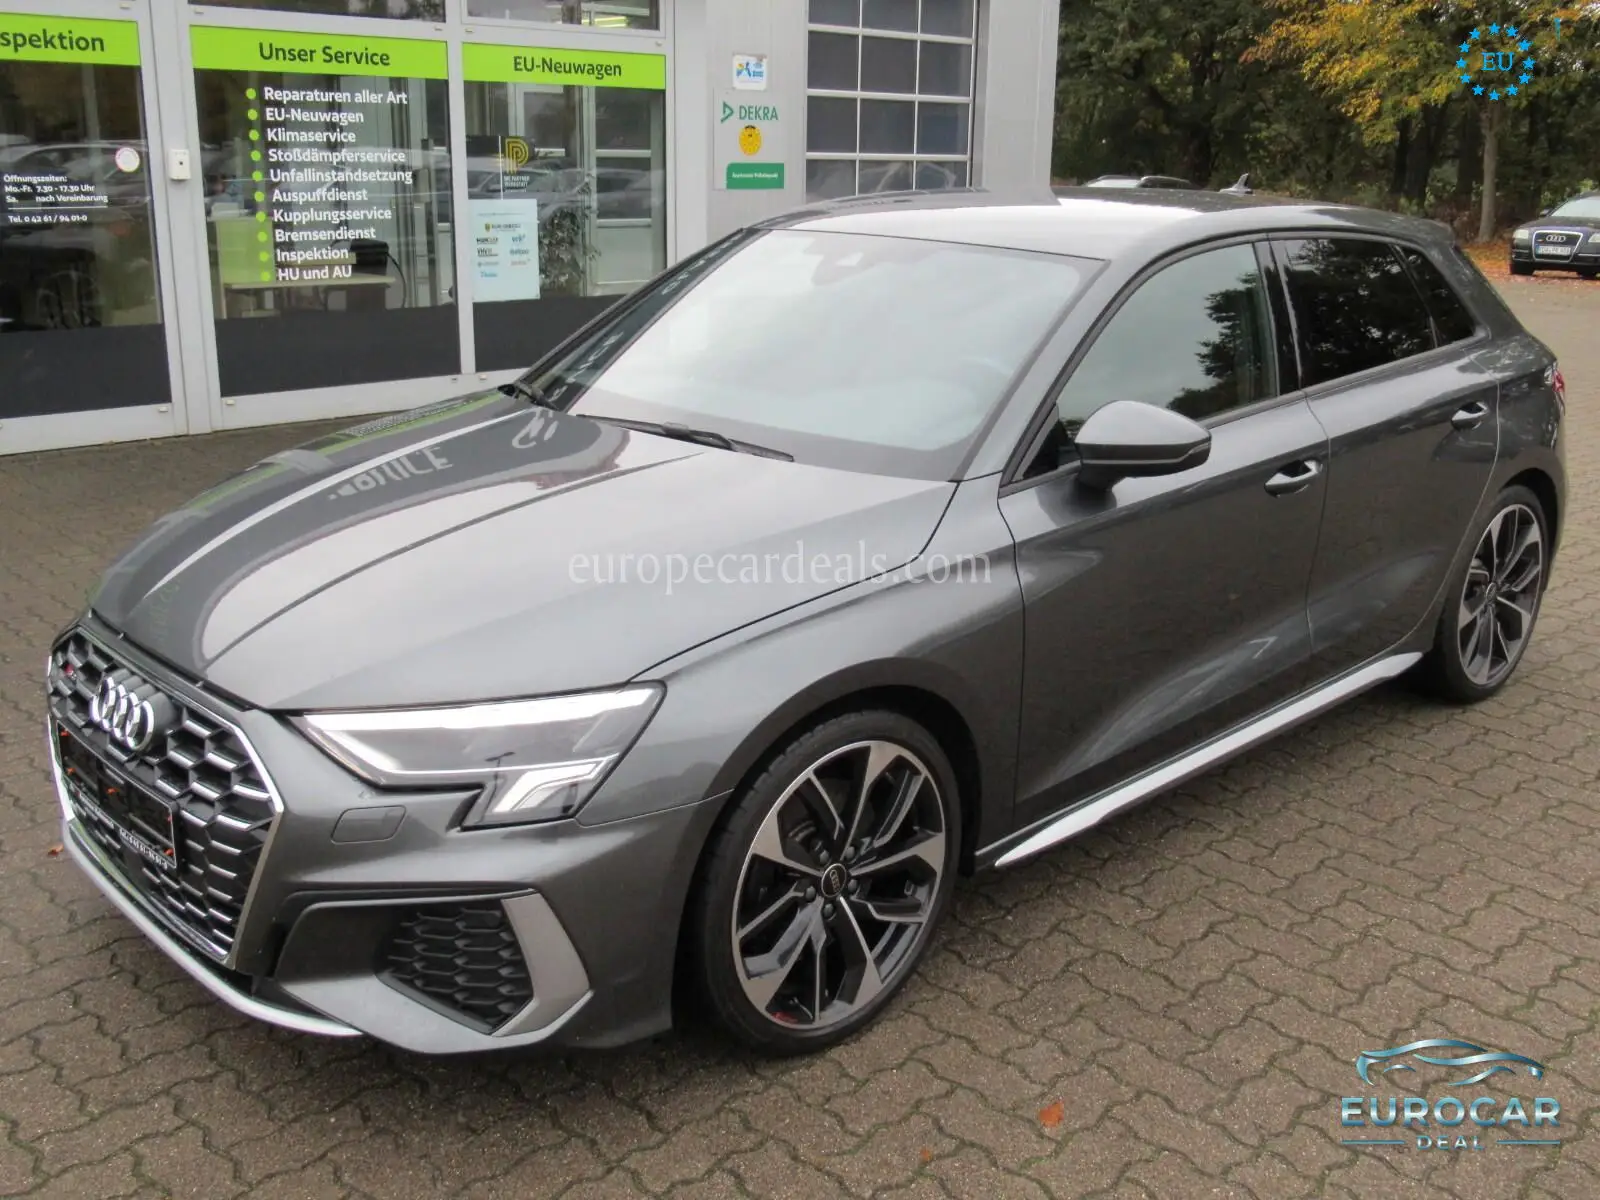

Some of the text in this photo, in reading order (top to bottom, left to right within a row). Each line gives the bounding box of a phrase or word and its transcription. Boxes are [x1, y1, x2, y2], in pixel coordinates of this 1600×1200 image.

[0, 29, 105, 53] spektion
[258, 42, 391, 66] Unser Service
[513, 55, 622, 80] EU-Neuwagen
[263, 87, 408, 104] Reparaturen aller Art
[265, 108, 364, 125] EU-Neuwagen
[738, 104, 779, 121] DEKRA
[267, 128, 356, 143] Klimaservice
[268, 148, 406, 165] Stoßdämpferservice
[270, 169, 413, 184] Unfallinstandsetzung
[80, 184, 96, 192] Uhr
[272, 188, 369, 203] Auspuffdienst
[56, 195, 109, 203] Vereinbarung
[8, 215, 23, 223] Tel.
[273, 207, 393, 224] Kupplungsservice
[275, 227, 377, 242] Bremsendienst
[276, 247, 349, 263] Inspektion
[278, 266, 353, 281] HU und AU
